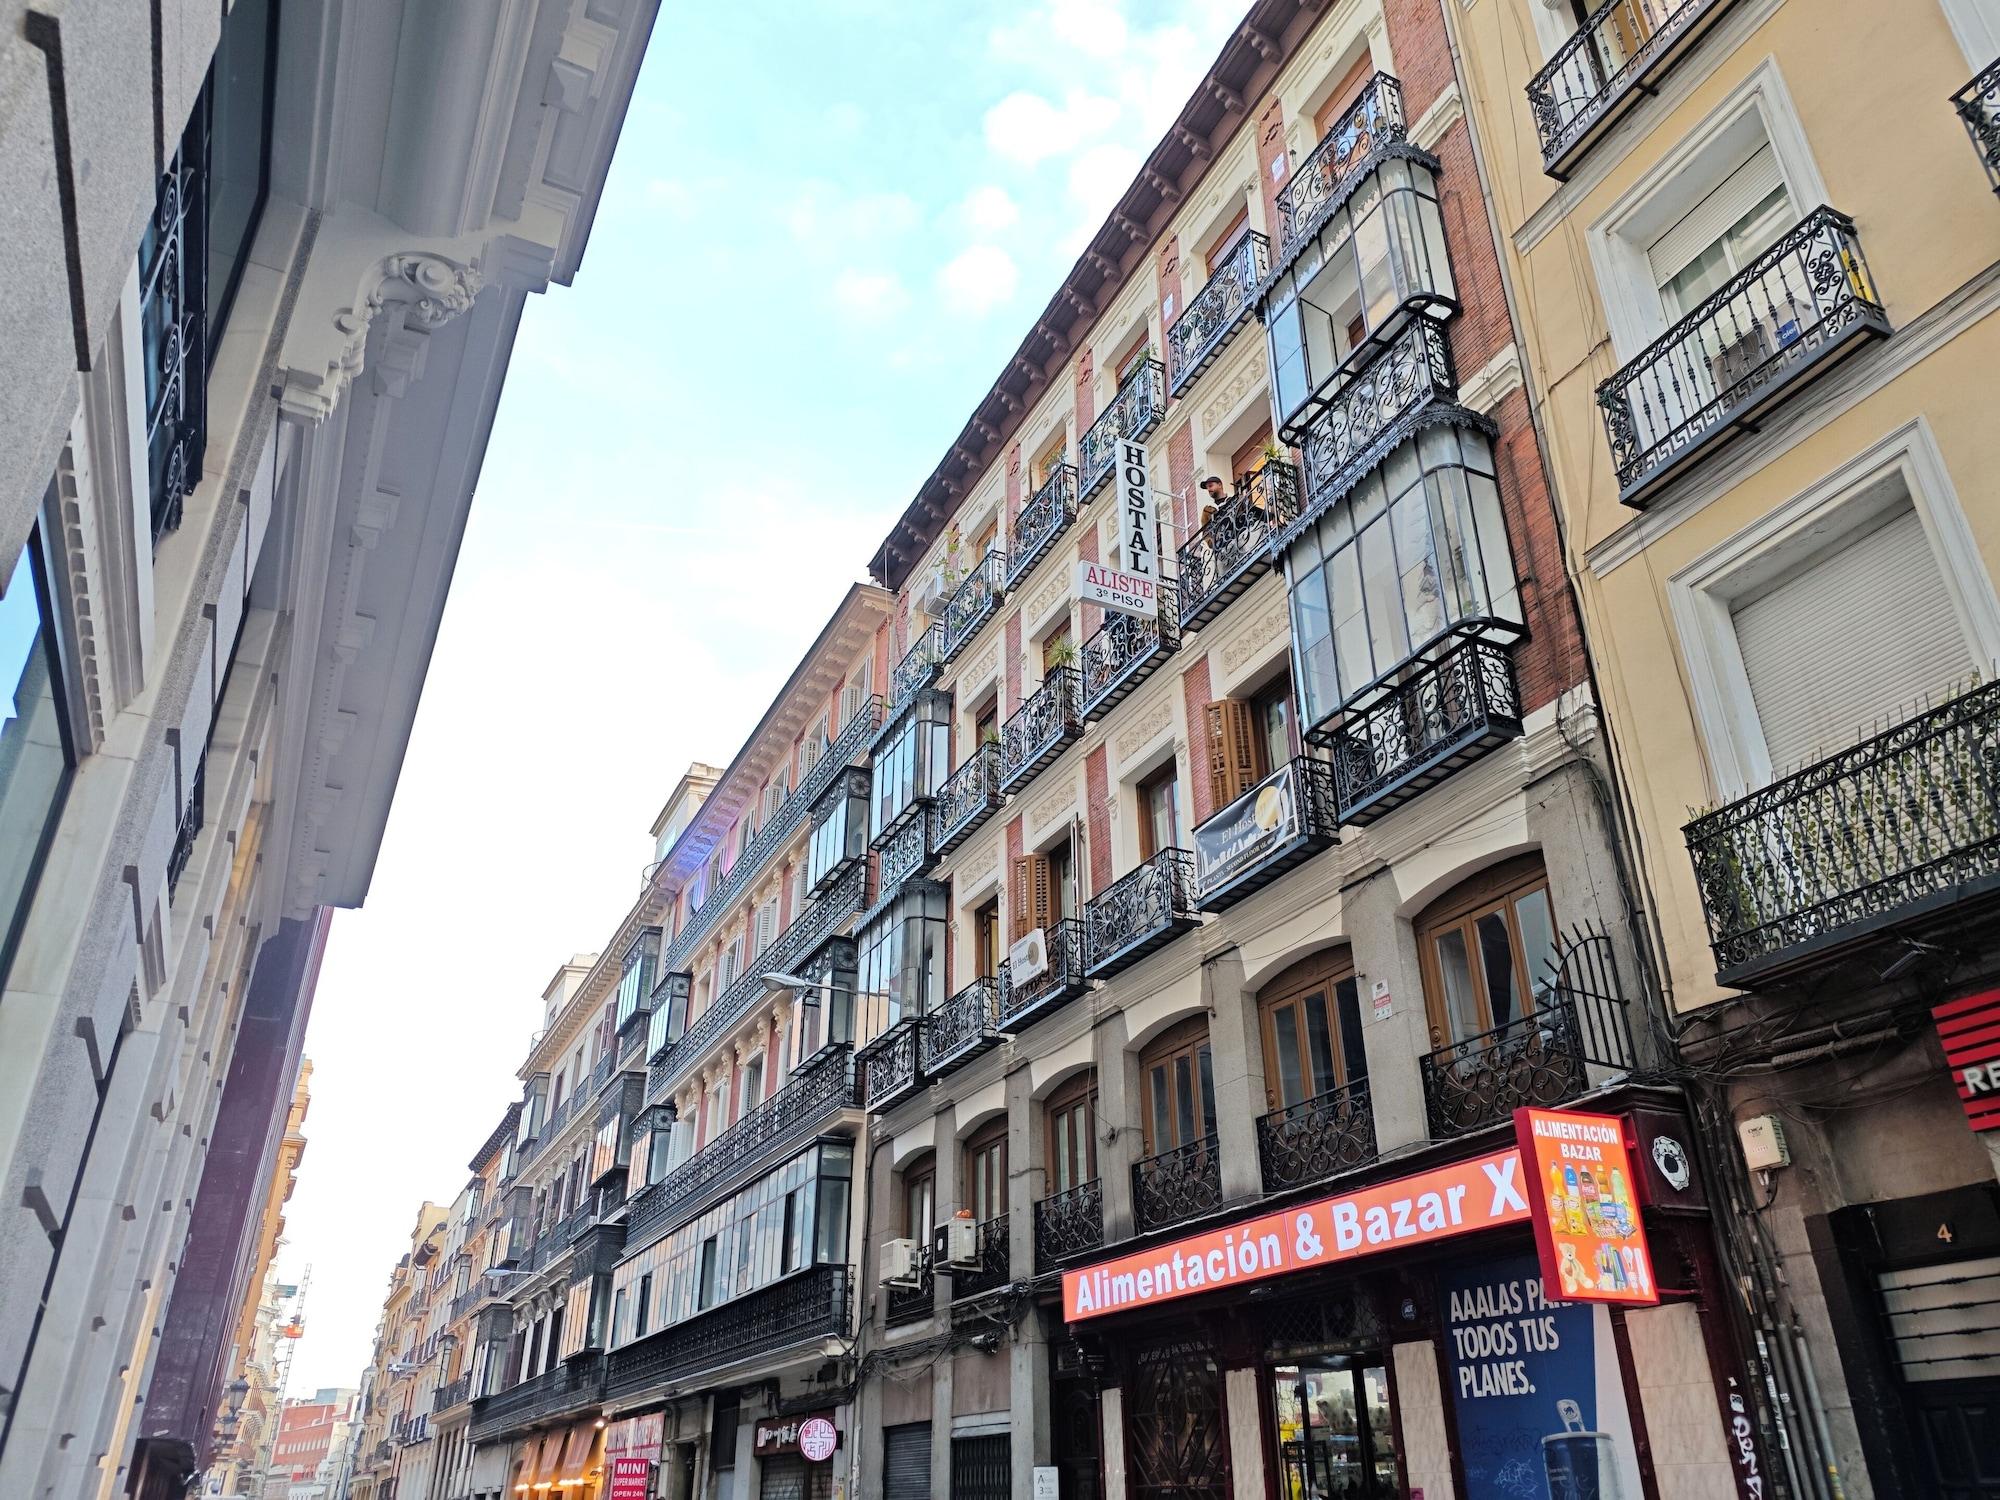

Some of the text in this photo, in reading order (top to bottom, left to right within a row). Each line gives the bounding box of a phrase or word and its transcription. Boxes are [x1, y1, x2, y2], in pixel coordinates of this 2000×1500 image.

[1123, 445, 1149, 575] HOSTAL
[1086, 565, 1154, 599] ALISTE
[1096, 587, 1144, 609] 3º PISO
[1962, 1060, 2000, 1095] RE
[1534, 1119, 1618, 1144] ALIMENTACIÓN
[1560, 1143, 1602, 1162] BAZAR
[1075, 1157, 1527, 1314] Alimentación & Bazar X
[1936, 1223, 1953, 1243] 4
[1450, 1280, 1523, 1323] AAALAS
[1452, 1316, 1560, 1360] TODOS TUS
[1458, 1360, 1537, 1399] PLANES.
[617, 1462, 646, 1475] MINI
